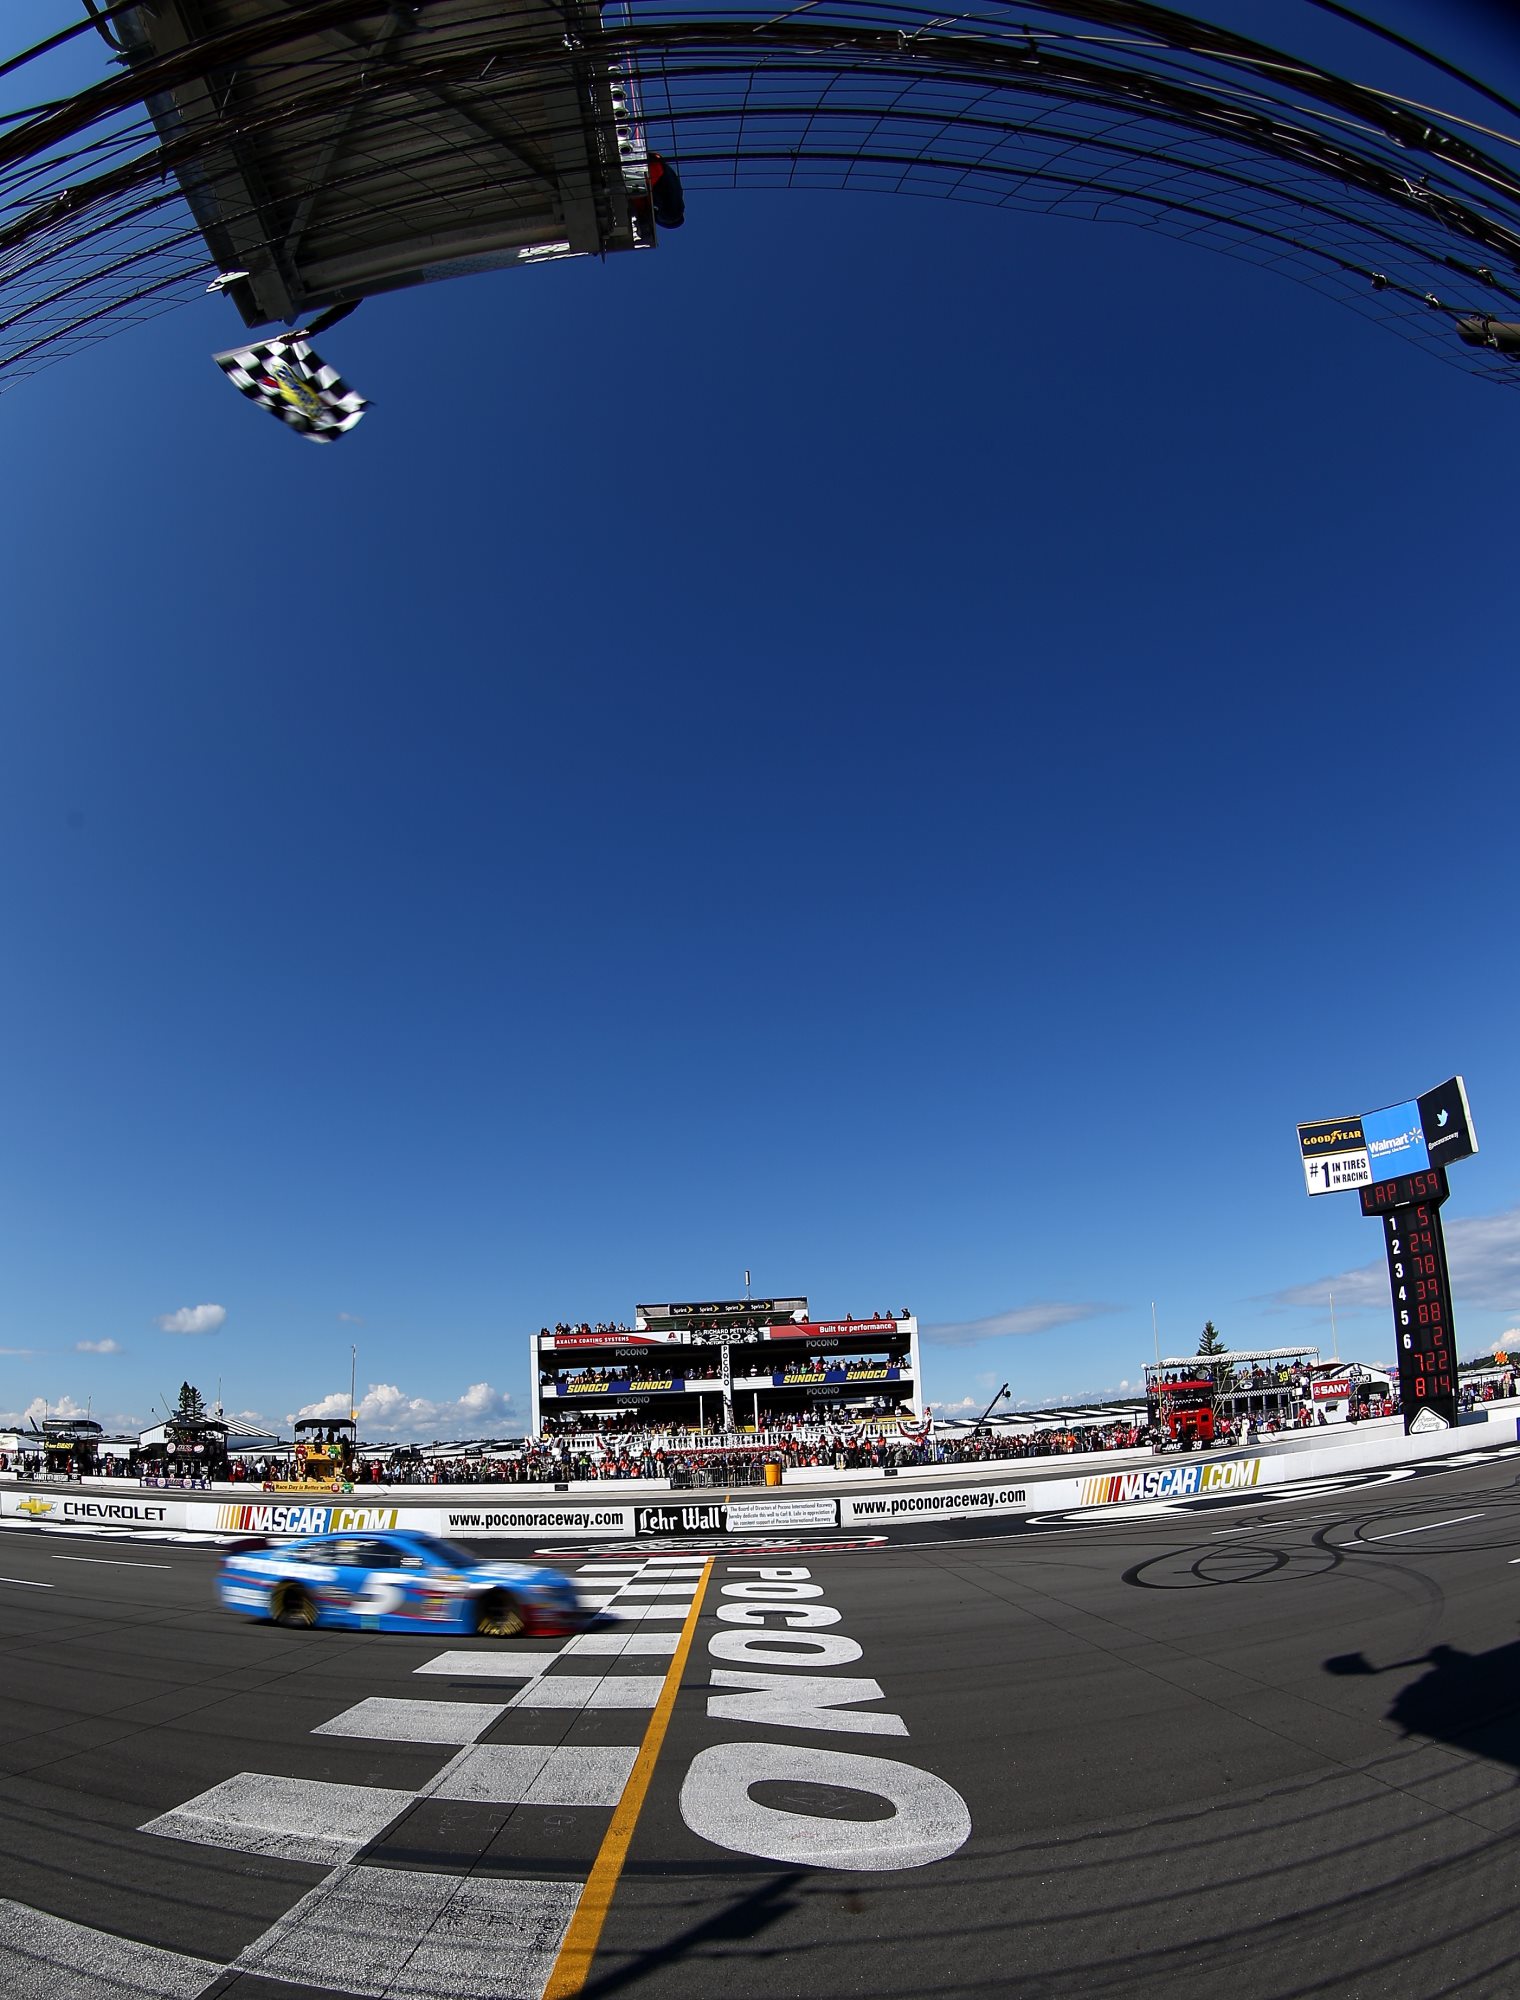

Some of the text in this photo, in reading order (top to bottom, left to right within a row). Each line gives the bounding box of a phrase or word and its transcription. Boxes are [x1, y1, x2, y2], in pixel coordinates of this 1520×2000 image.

[1303, 1130, 1361, 1145] GOODYEAR
[1368, 1133, 1409, 1153] Walmart
[1332, 1158, 1366, 1172] IN TIRES
[1333, 1171, 1368, 1184] IN RACING
[1364, 1173, 1438, 1207] LAP 159
[1389, 1207, 1428, 1230] 1 5
[1392, 1232, 1432, 1254] 2 24
[1395, 1254, 1435, 1278] 3 78
[1399, 1279, 1438, 1300] 4 39
[1401, 1302, 1440, 1325] 5 88
[849, 1323, 894, 1334] performance.
[806, 1339, 839, 1348] POCONO
[1403, 1326, 1443, 1349] 6 2
[616, 1348, 648, 1356] POCONO
[1414, 1350, 1448, 1371] 722
[783, 1369, 888, 1384] SUNOCO SUNOCO
[1278, 1371, 1289, 1382] 39
[566, 1380, 672, 1393] SUNOCO SUNOCO
[807, 1386, 840, 1395] POCONO
[1320, 1384, 1348, 1395] SANY
[617, 1396, 650, 1405] POCONO
[1192, 1441, 1203, 1450] 39
[853, 1489, 1026, 1515] www.poconoraceway.com
[64, 1502, 167, 1520] CHEVROLET
[449, 1512, 623, 1529] www.poconoraceway.com
[639, 1507, 720, 1534] Lehr Wall
[348, 1572, 415, 1615] 5
[679, 1567, 972, 1871] POCONO
